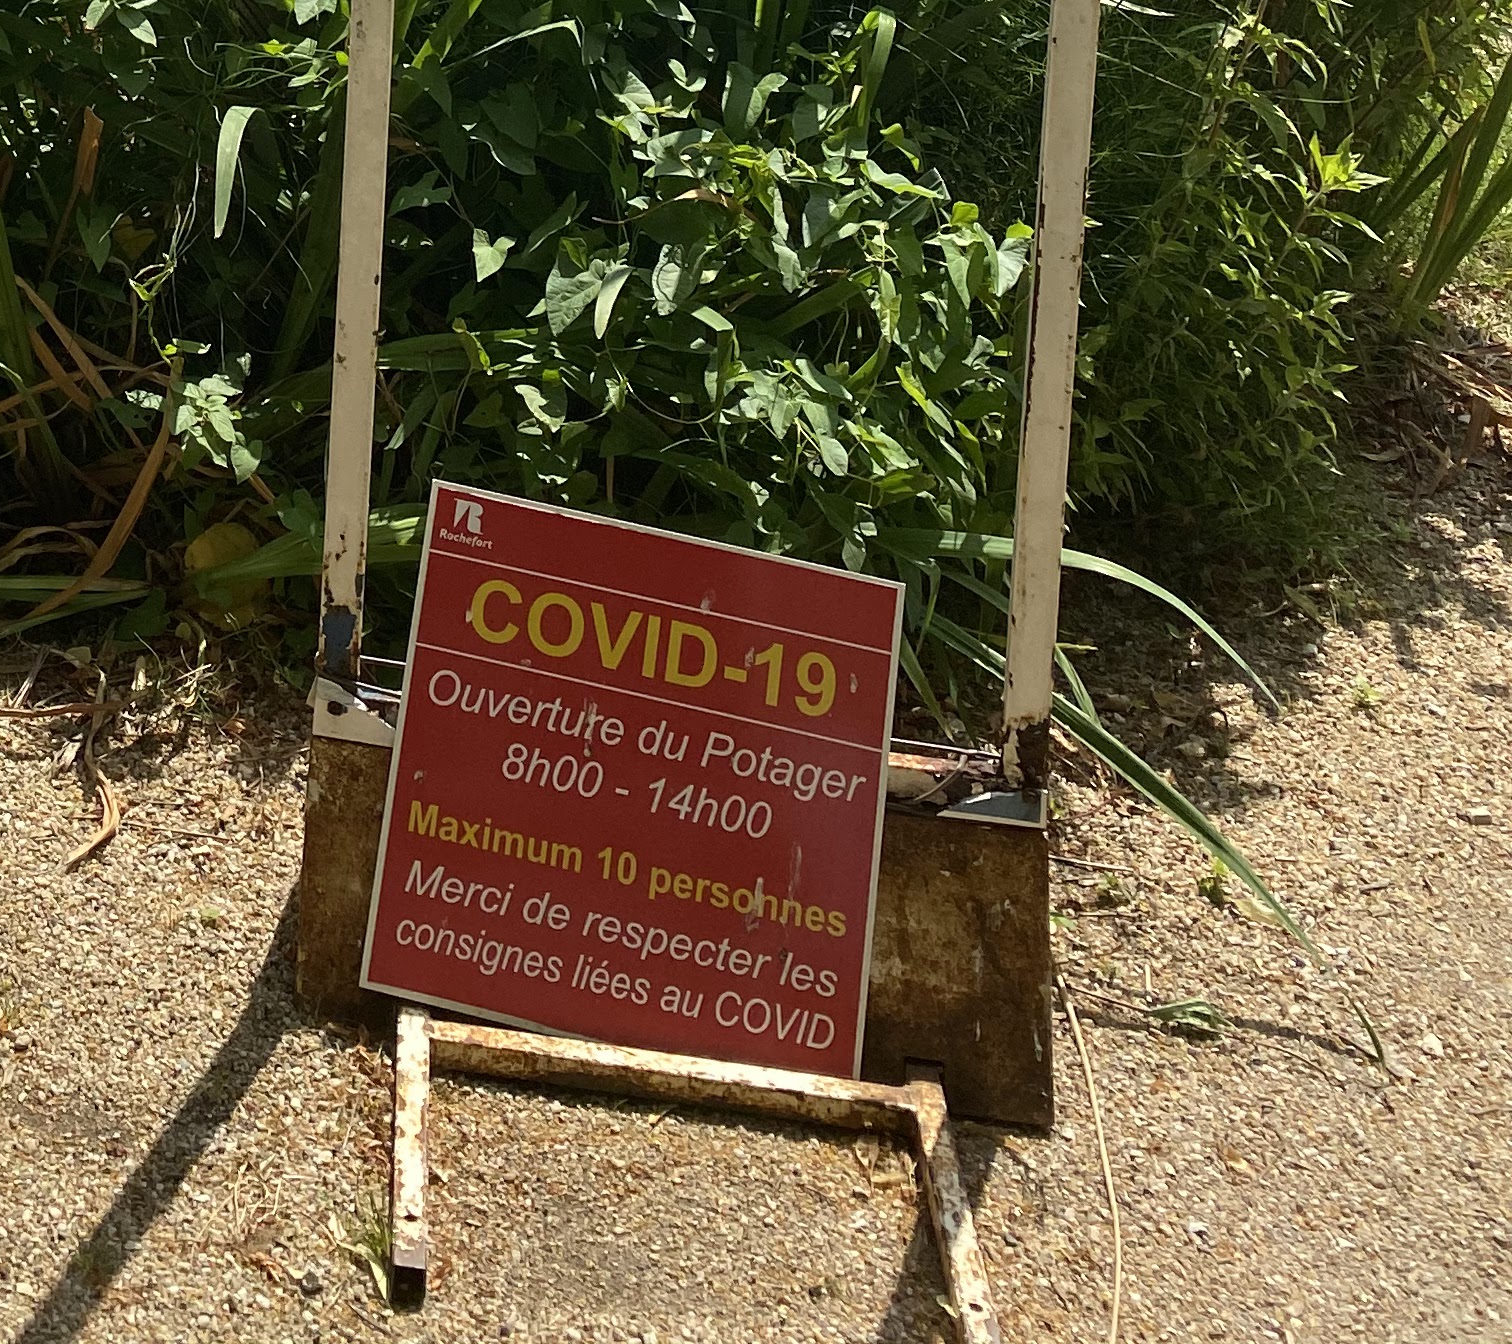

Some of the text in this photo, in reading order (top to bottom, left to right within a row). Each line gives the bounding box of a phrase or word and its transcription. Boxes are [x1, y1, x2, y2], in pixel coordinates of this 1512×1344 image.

[439, 528, 493, 550] Rochefort
[470, 579, 837, 717] COVID-19
[428, 669, 867, 802] Ouverture du Potager
[502, 743, 772, 839] 8h00 - 14h00
[404, 860, 838, 997] Merci de respecter les
[408, 800, 846, 937] Maximum 10 personnes
[396, 919, 835, 1049] consignes liées au COVID
